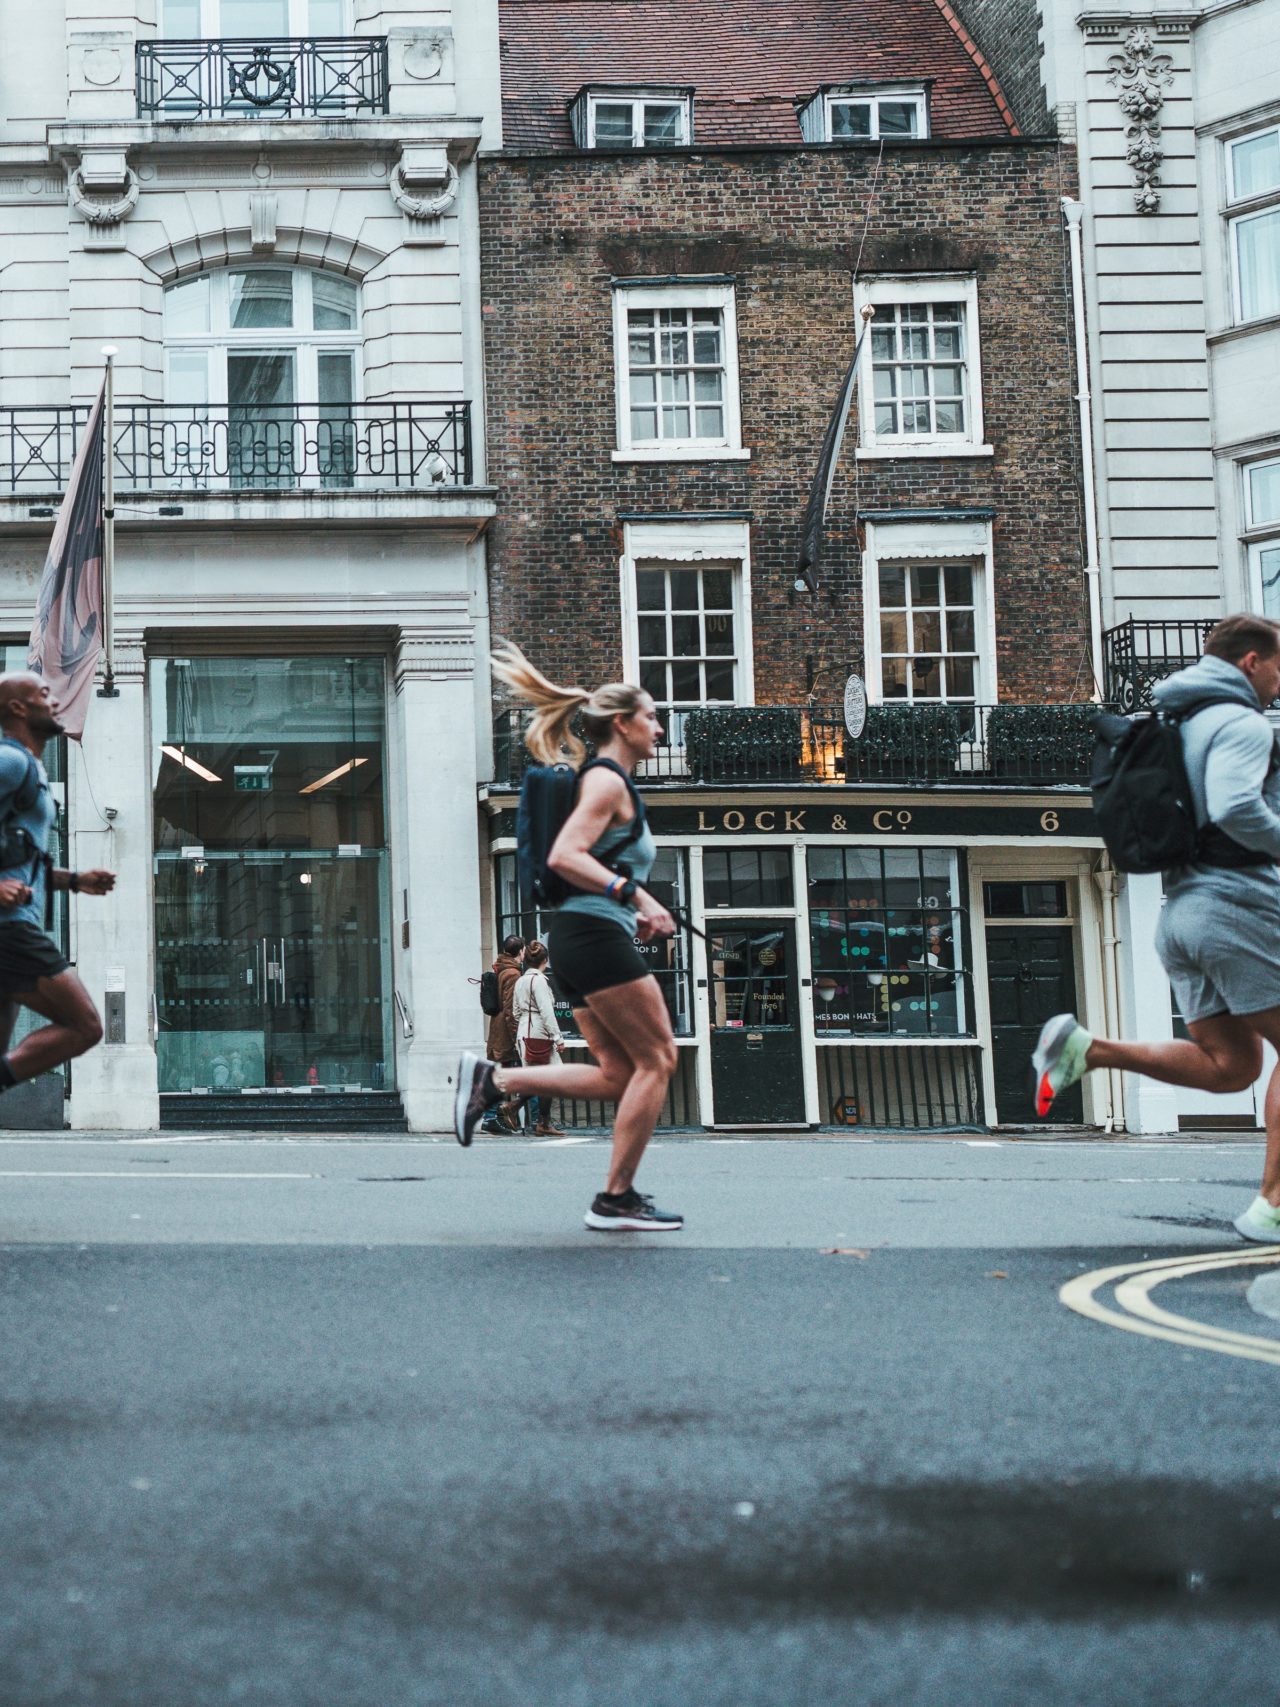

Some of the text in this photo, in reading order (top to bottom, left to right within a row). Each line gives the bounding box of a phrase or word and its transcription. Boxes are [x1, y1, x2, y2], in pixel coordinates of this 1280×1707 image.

[698, 810, 807, 831] LOCK
[831, 814, 848, 831] &
[1039, 811, 1060, 832] 6
[753, 992, 785, 1000] Founded
[857, 1012, 877, 1021] HATS
